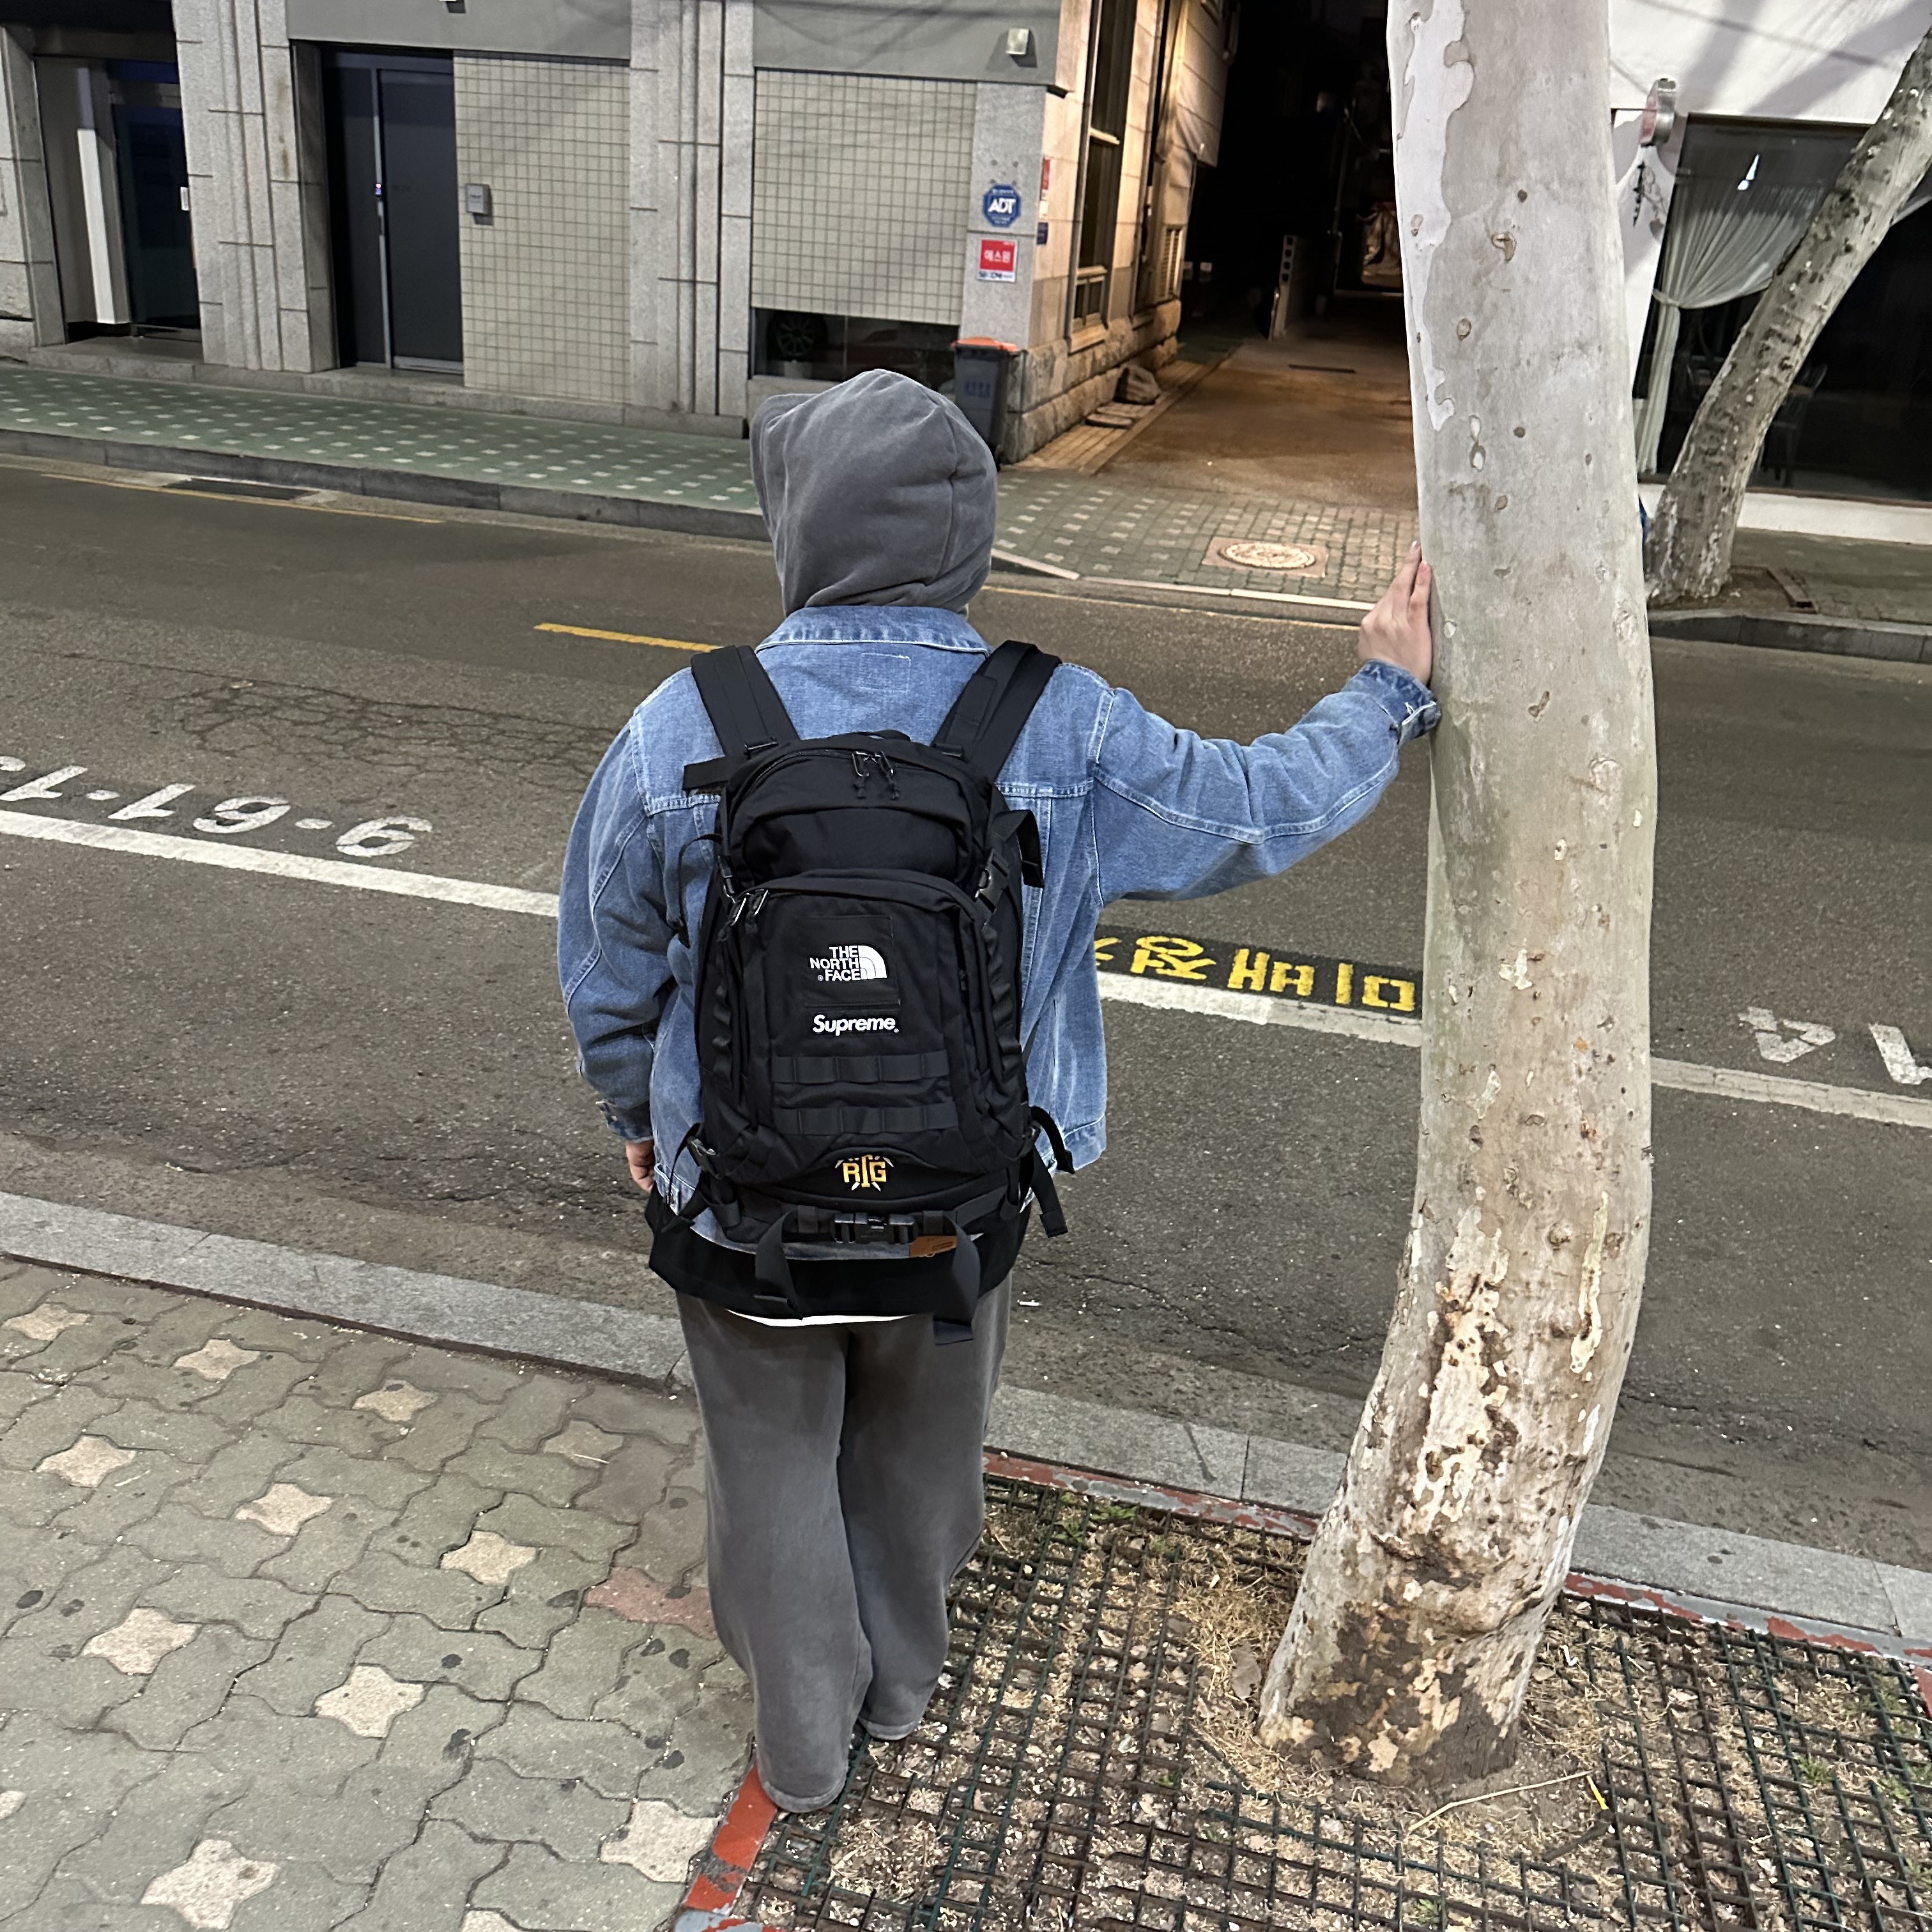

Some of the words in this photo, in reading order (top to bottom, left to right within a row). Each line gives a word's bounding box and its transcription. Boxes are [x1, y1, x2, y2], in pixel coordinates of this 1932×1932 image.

[988, 198, 1016, 214] ADT
[829, 946, 858, 958] THE
[809, 957, 859, 970] NORTH
[825, 969, 861, 981] FACE
[812, 1014, 896, 1036] Supreme
